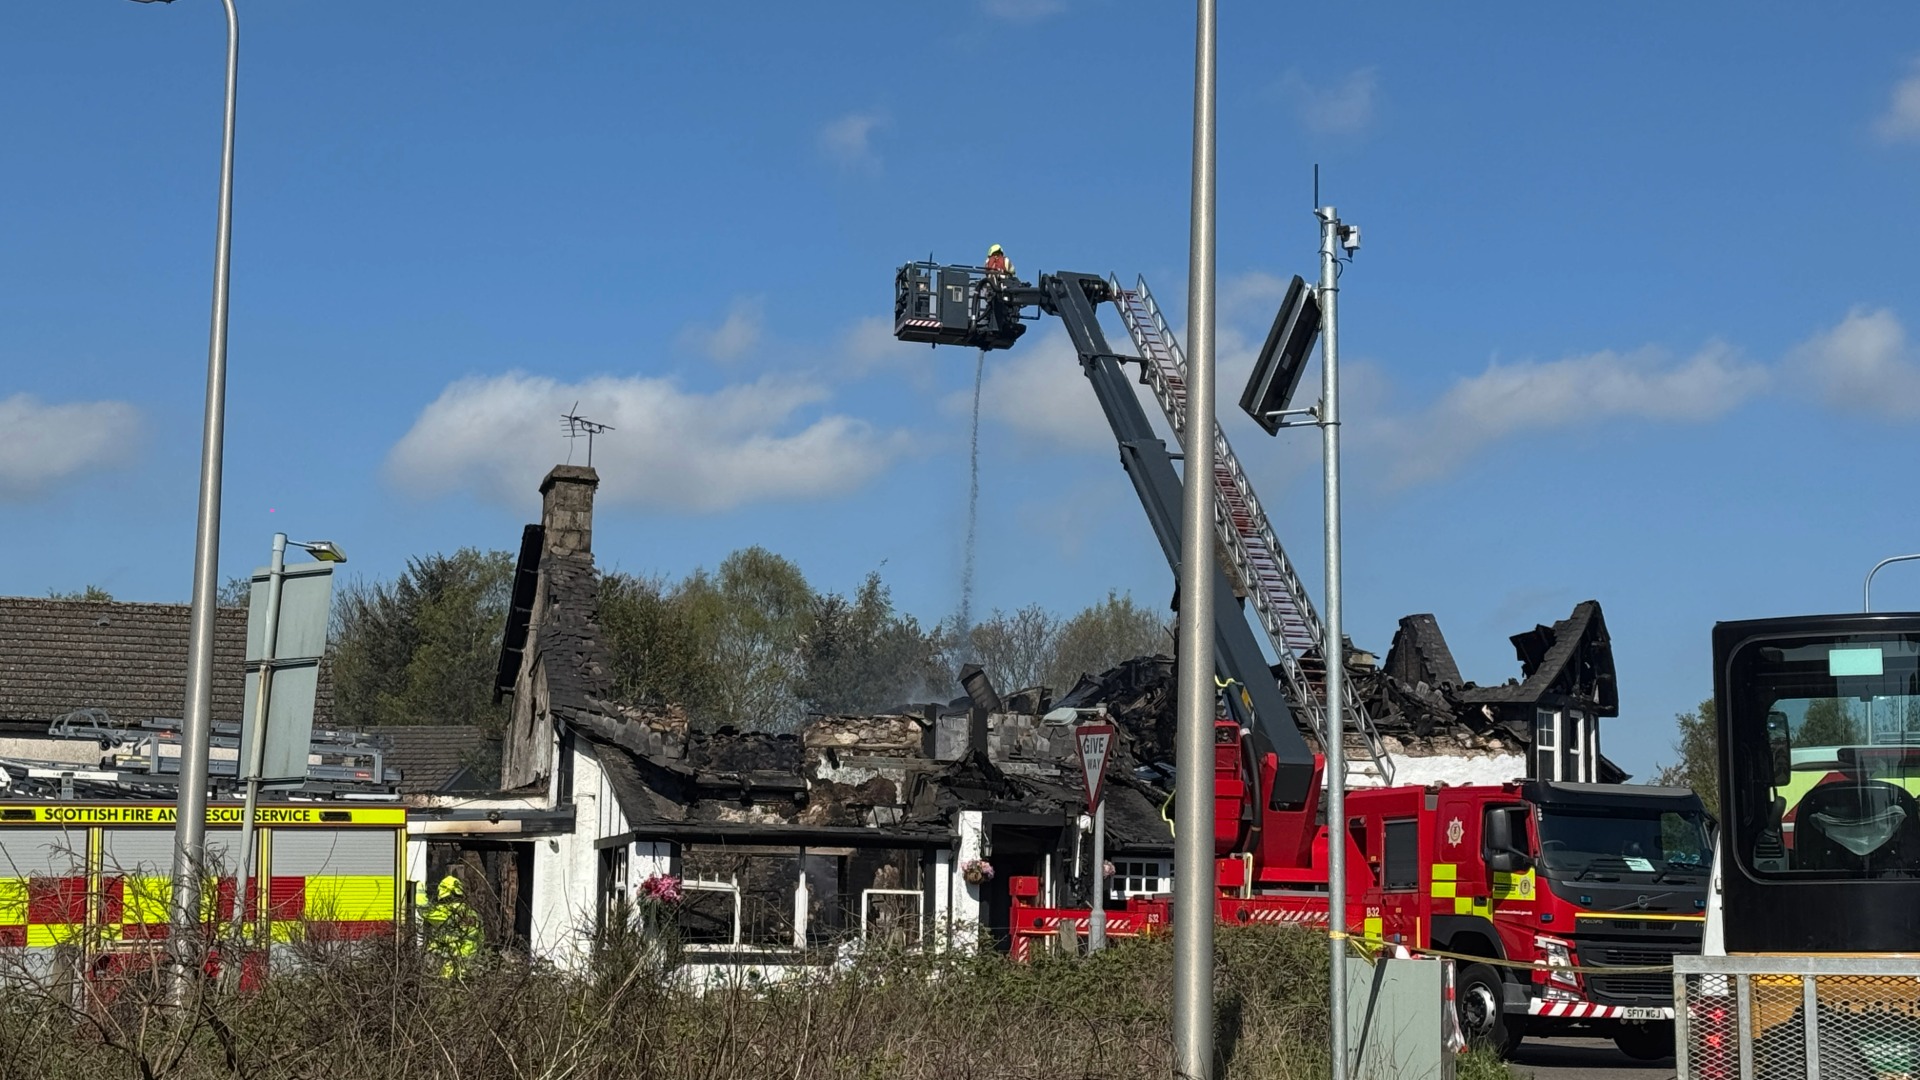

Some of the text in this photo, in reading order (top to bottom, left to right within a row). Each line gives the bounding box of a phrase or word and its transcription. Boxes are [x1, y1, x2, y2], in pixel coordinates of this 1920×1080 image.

[1083, 737, 1105, 754] GIVE
[1087, 758, 1101, 770] WAY
[44, 808, 118, 821] SCOTTISH
[122, 808, 153, 821] FIRE
[157, 808, 178, 821] AN
[254, 809, 311, 822] SERVICE
[1366, 907, 1380, 917] B32
[1627, 1009, 1661, 1019] SF17 WGJ
